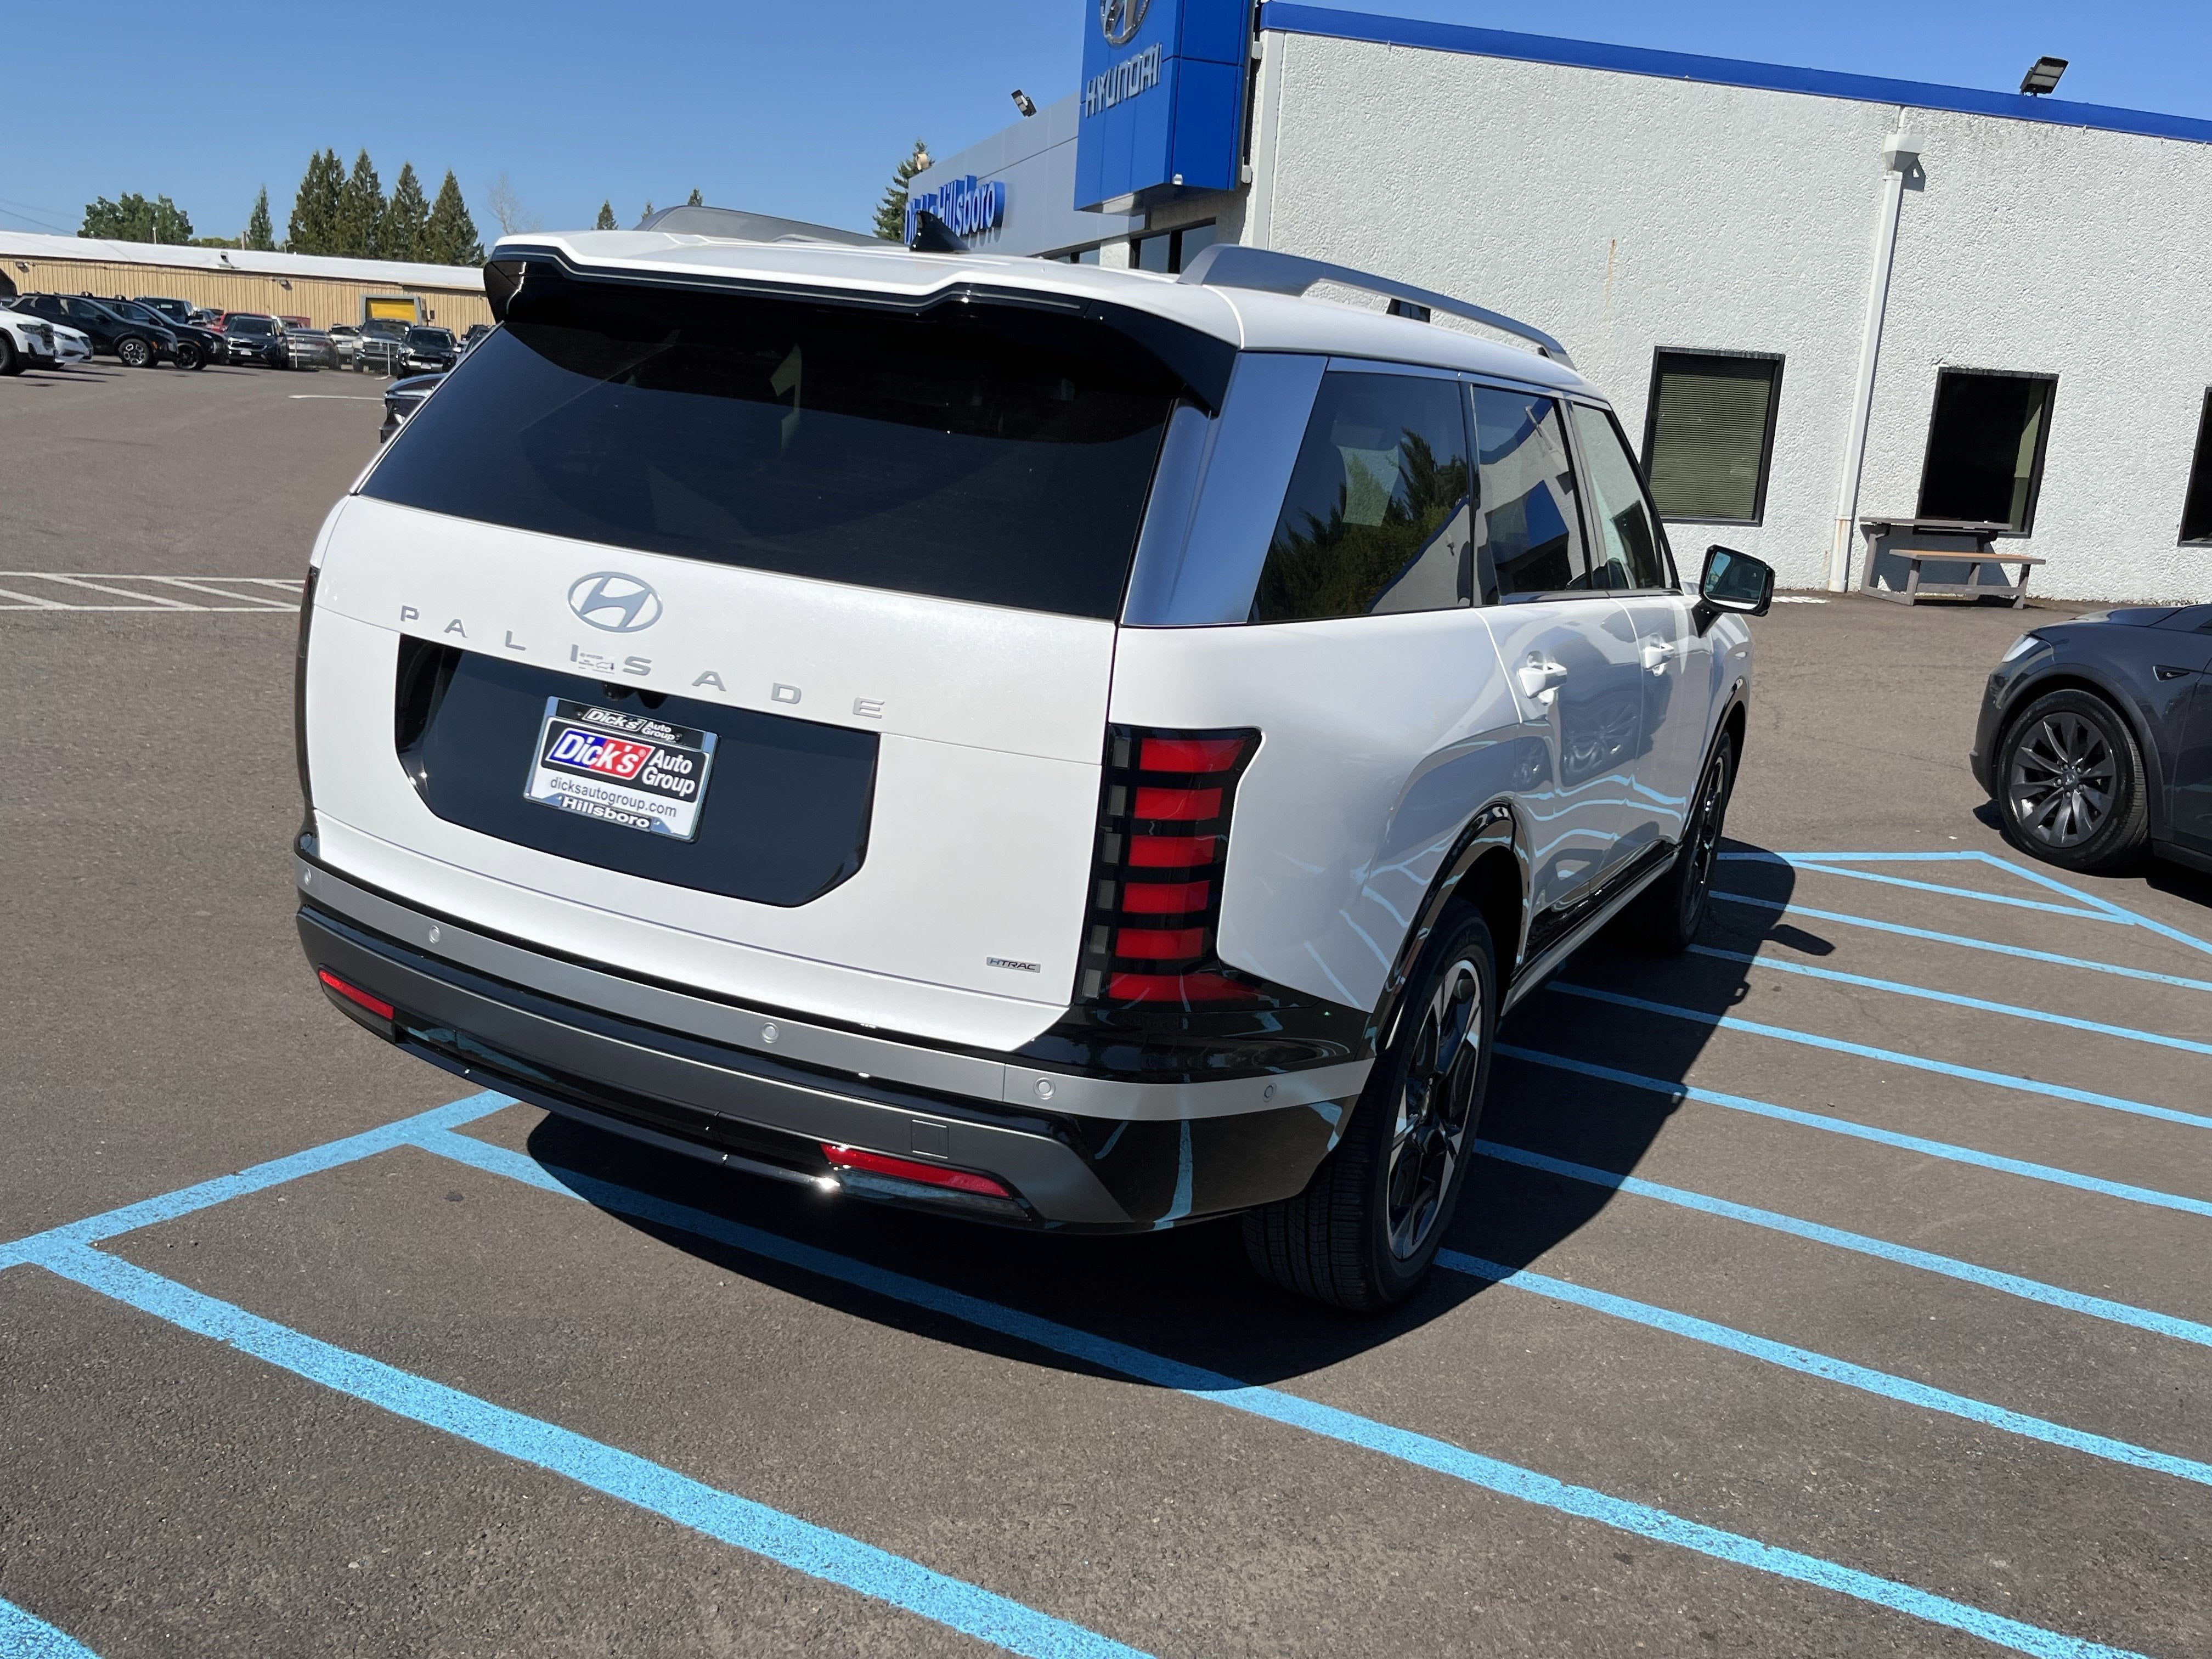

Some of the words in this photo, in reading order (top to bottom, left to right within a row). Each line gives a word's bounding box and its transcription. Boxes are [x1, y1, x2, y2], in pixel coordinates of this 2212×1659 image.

[1085, 42, 1162, 117] HYUNDAI
[938, 175, 1000, 238] Hillsboro
[399, 605, 885, 720] PALISADE
[586, 710, 641, 730] Dick's
[641, 727, 675, 741] Group
[646, 721, 672, 733] Auto
[648, 749, 693, 774] Auto
[642, 768, 696, 796] Group
[550, 776, 678, 818] dicksautogroup.com
[561, 795, 651, 830] Hillsboro
[990, 958, 1036, 970] HTRAC
